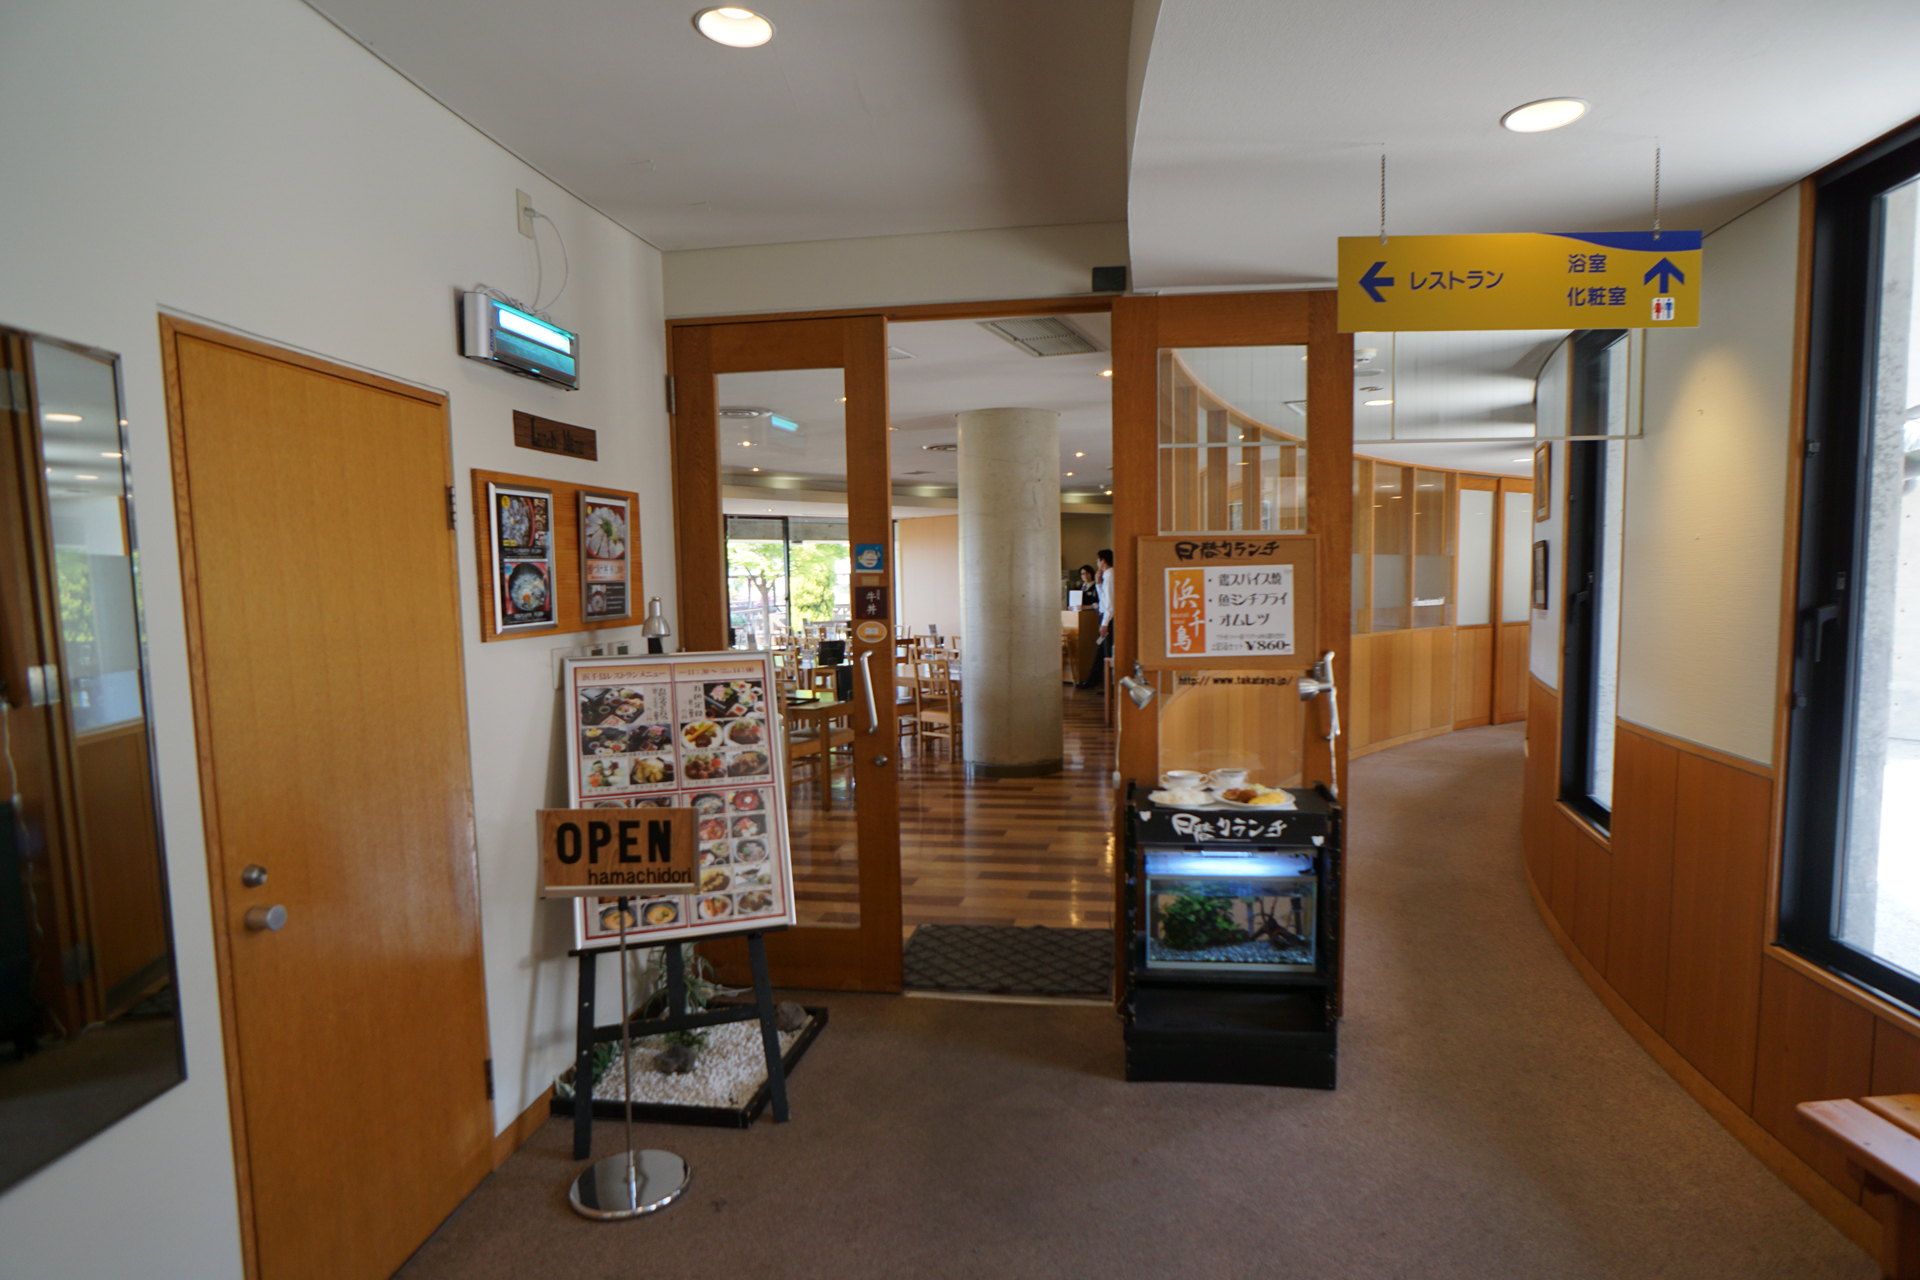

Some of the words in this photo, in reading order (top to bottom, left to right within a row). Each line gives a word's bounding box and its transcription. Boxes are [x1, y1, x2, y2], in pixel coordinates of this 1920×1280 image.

[1567, 253, 1607, 273] 浴室
[1410, 270, 1504, 290] レストラン
[1567, 286, 1626, 306] 化粧室
[1172, 578, 1206, 651] 浜千鳥
[1219, 613, 1270, 626] オムレツ
[556, 820, 672, 864] OPEN
[588, 868, 692, 886] hamachidori
